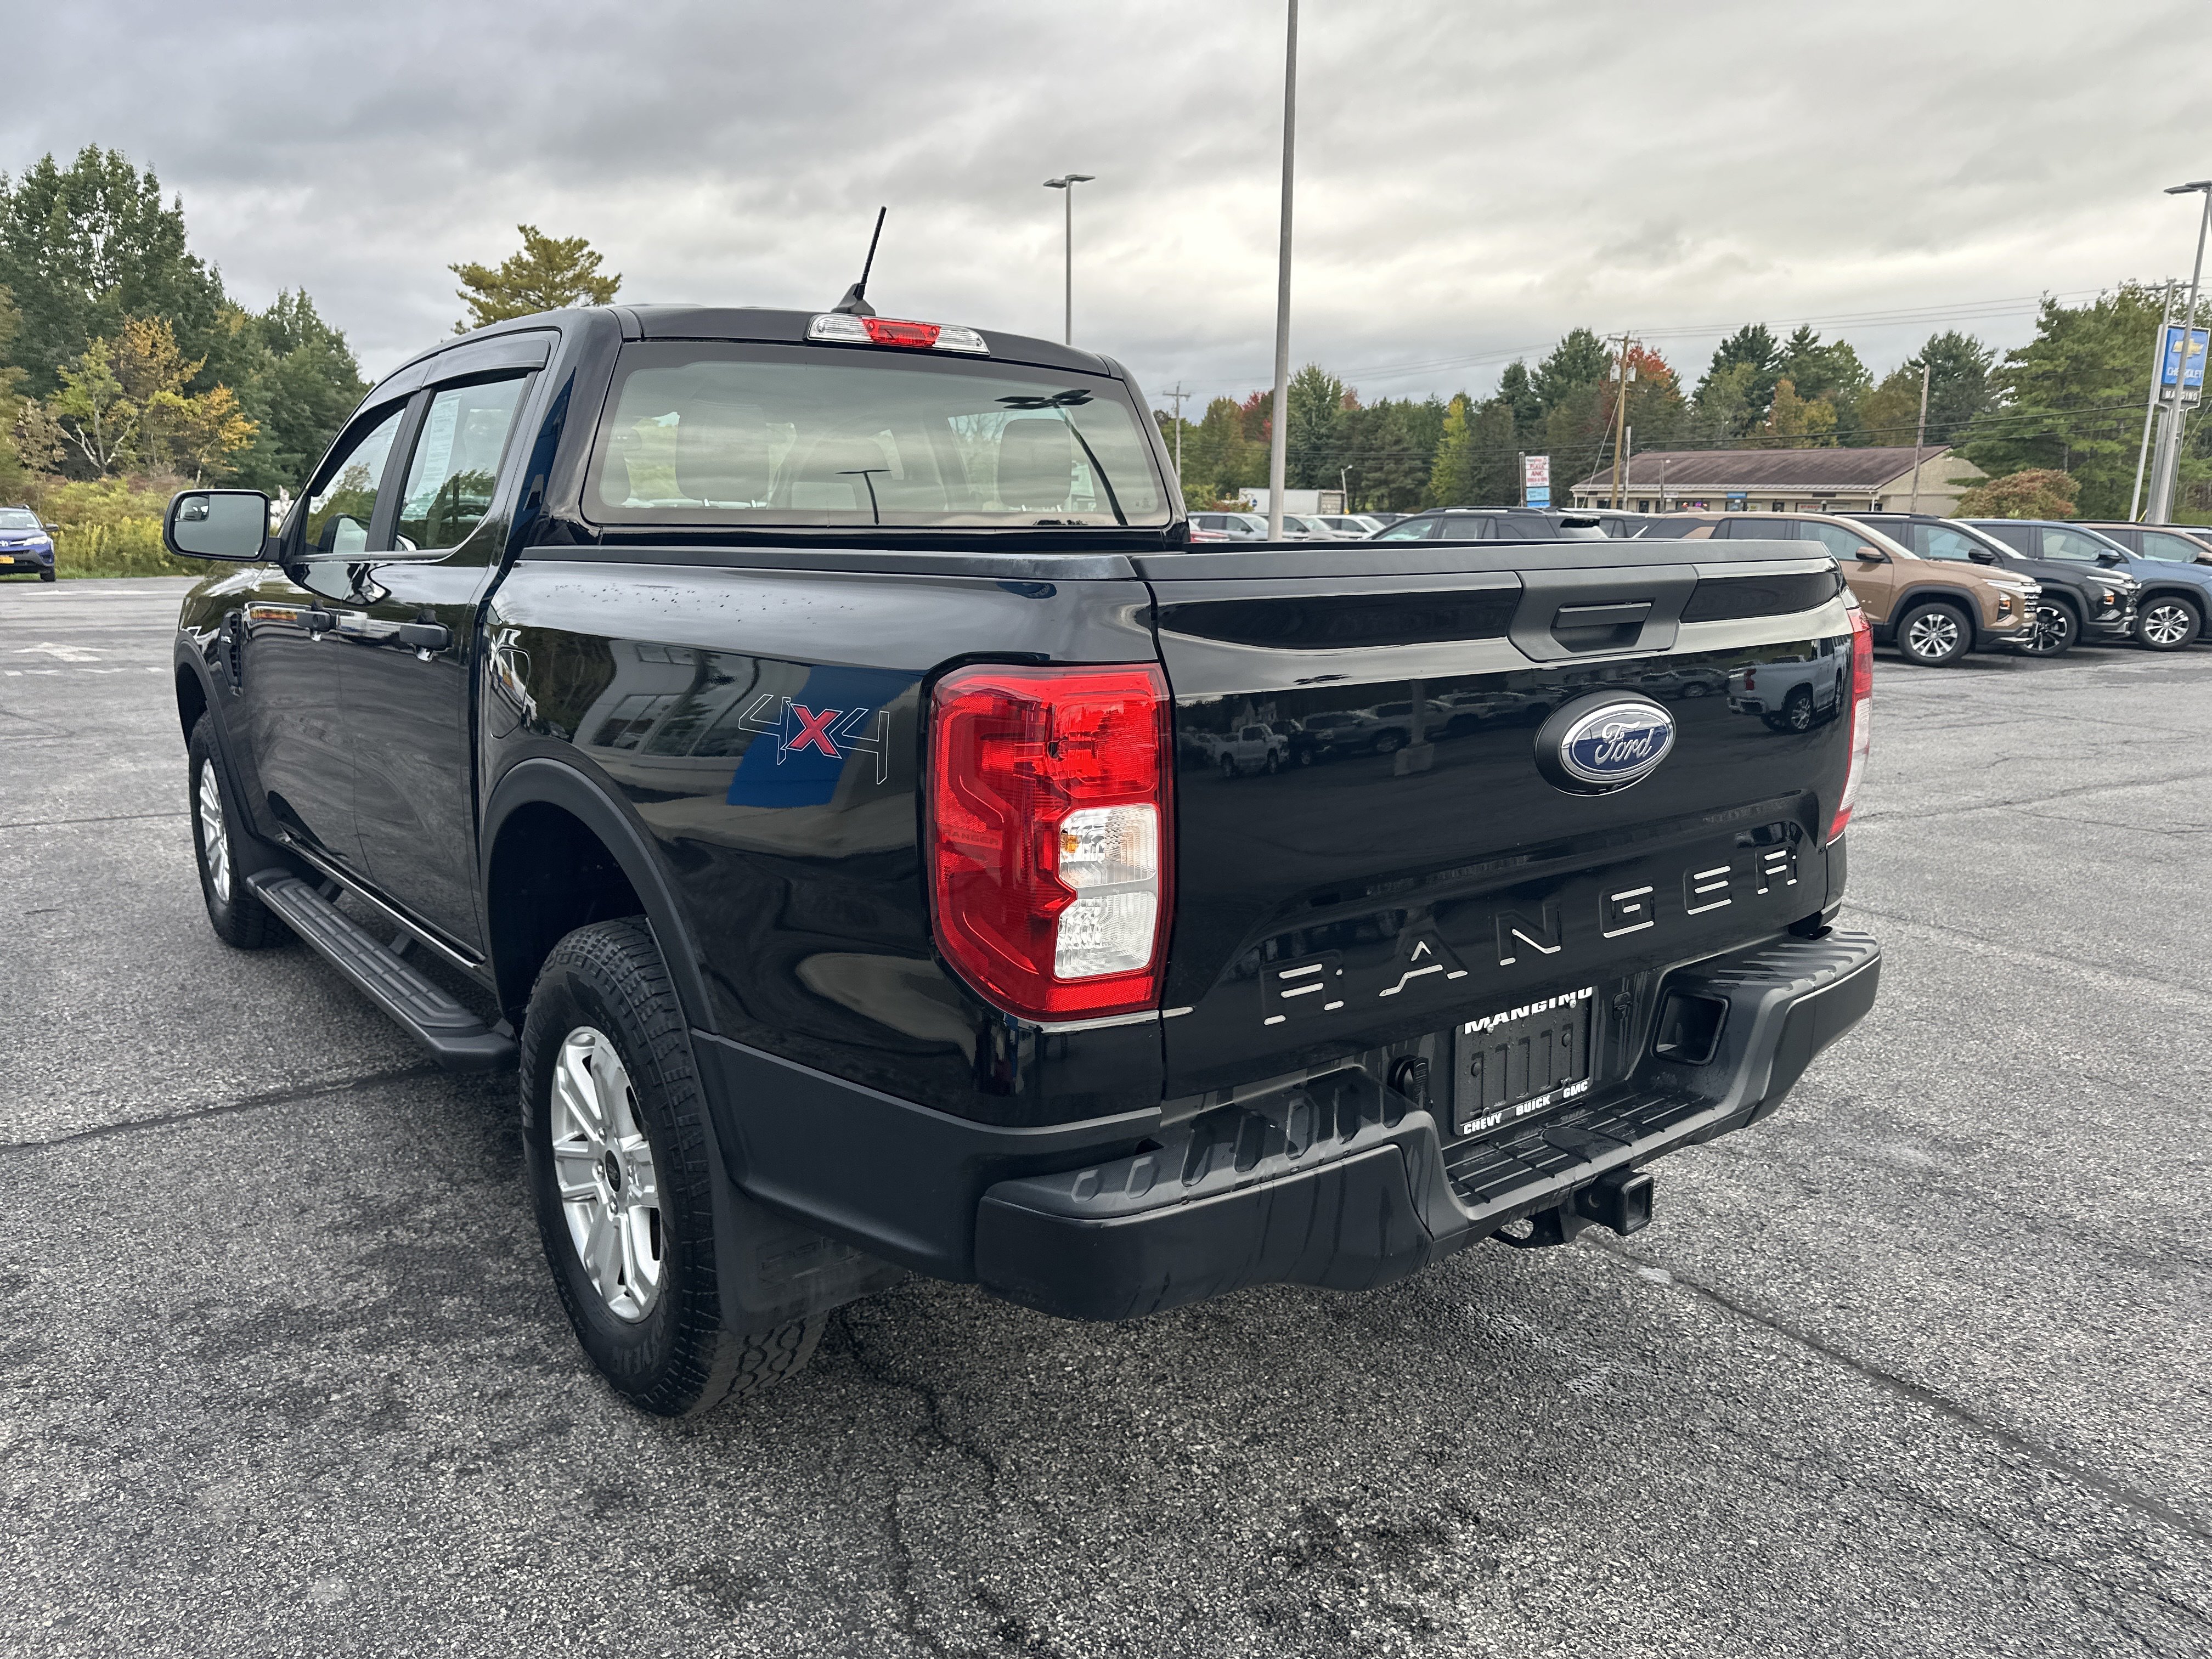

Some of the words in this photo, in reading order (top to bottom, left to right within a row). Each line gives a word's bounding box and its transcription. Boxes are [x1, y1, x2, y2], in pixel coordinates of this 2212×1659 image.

[2166, 367, 2203, 378] CHEROLET
[2165, 390, 2198, 400] MAGINO
[1594, 721, 1655, 765] Ford
[942, 829, 999, 846] RANGER
[1262, 845, 1798, 1025] RANGER
[1464, 986, 1593, 1034] MANGINO
[1463, 1113, 1502, 1135] CHEVY
[1515, 1095, 1551, 1116] BUICK
[1562, 1081, 1588, 1098] GMC
